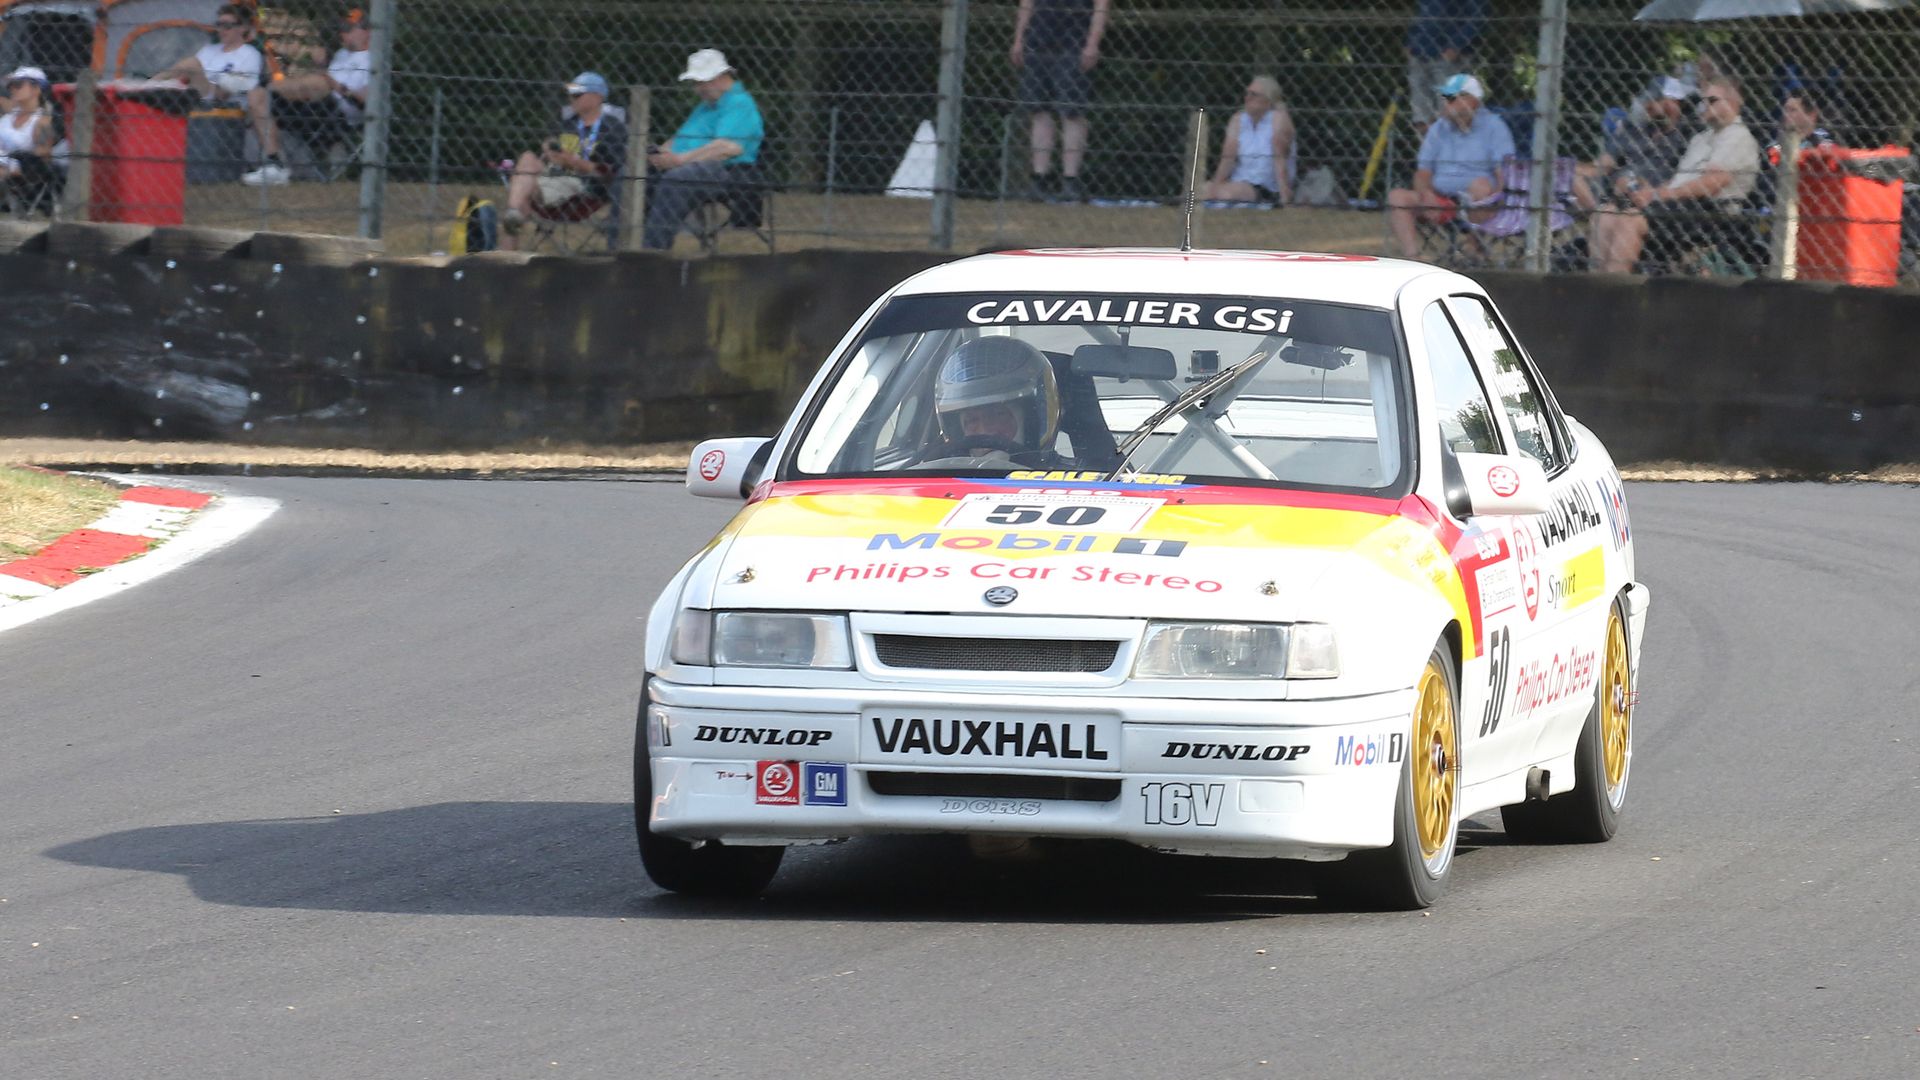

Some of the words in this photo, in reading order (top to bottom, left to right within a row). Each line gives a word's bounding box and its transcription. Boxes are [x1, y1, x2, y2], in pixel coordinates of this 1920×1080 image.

[966, 300, 1201, 325] CAVALIER
[1213, 305, 1294, 334] GSi
[1007, 470, 1187, 486] SCALETRIC
[985, 505, 1107, 526] 50
[1535, 479, 1601, 549] VAUXHALL
[866, 533, 1097, 551] Mobil
[806, 563, 951, 583] Philips
[970, 563, 1057, 580] Car
[1072, 565, 1223, 593] Stereo
[1547, 572, 1576, 609] Sport
[1479, 625, 1510, 739] 50
[1511, 660, 1547, 719] Philips
[1547, 653, 1568, 704] Car
[1564, 645, 1595, 698] Stereo
[694, 725, 832, 746] DUNLOP
[872, 718, 1108, 761] VAUXHALL
[1335, 733, 1385, 766] Mobil
[1390, 733, 1402, 763] 1
[1161, 742, 1311, 761] DUNLOP
[815, 772, 837, 791] GM
[940, 799, 1042, 816] DCRS
[1141, 782, 1225, 827] 16V
